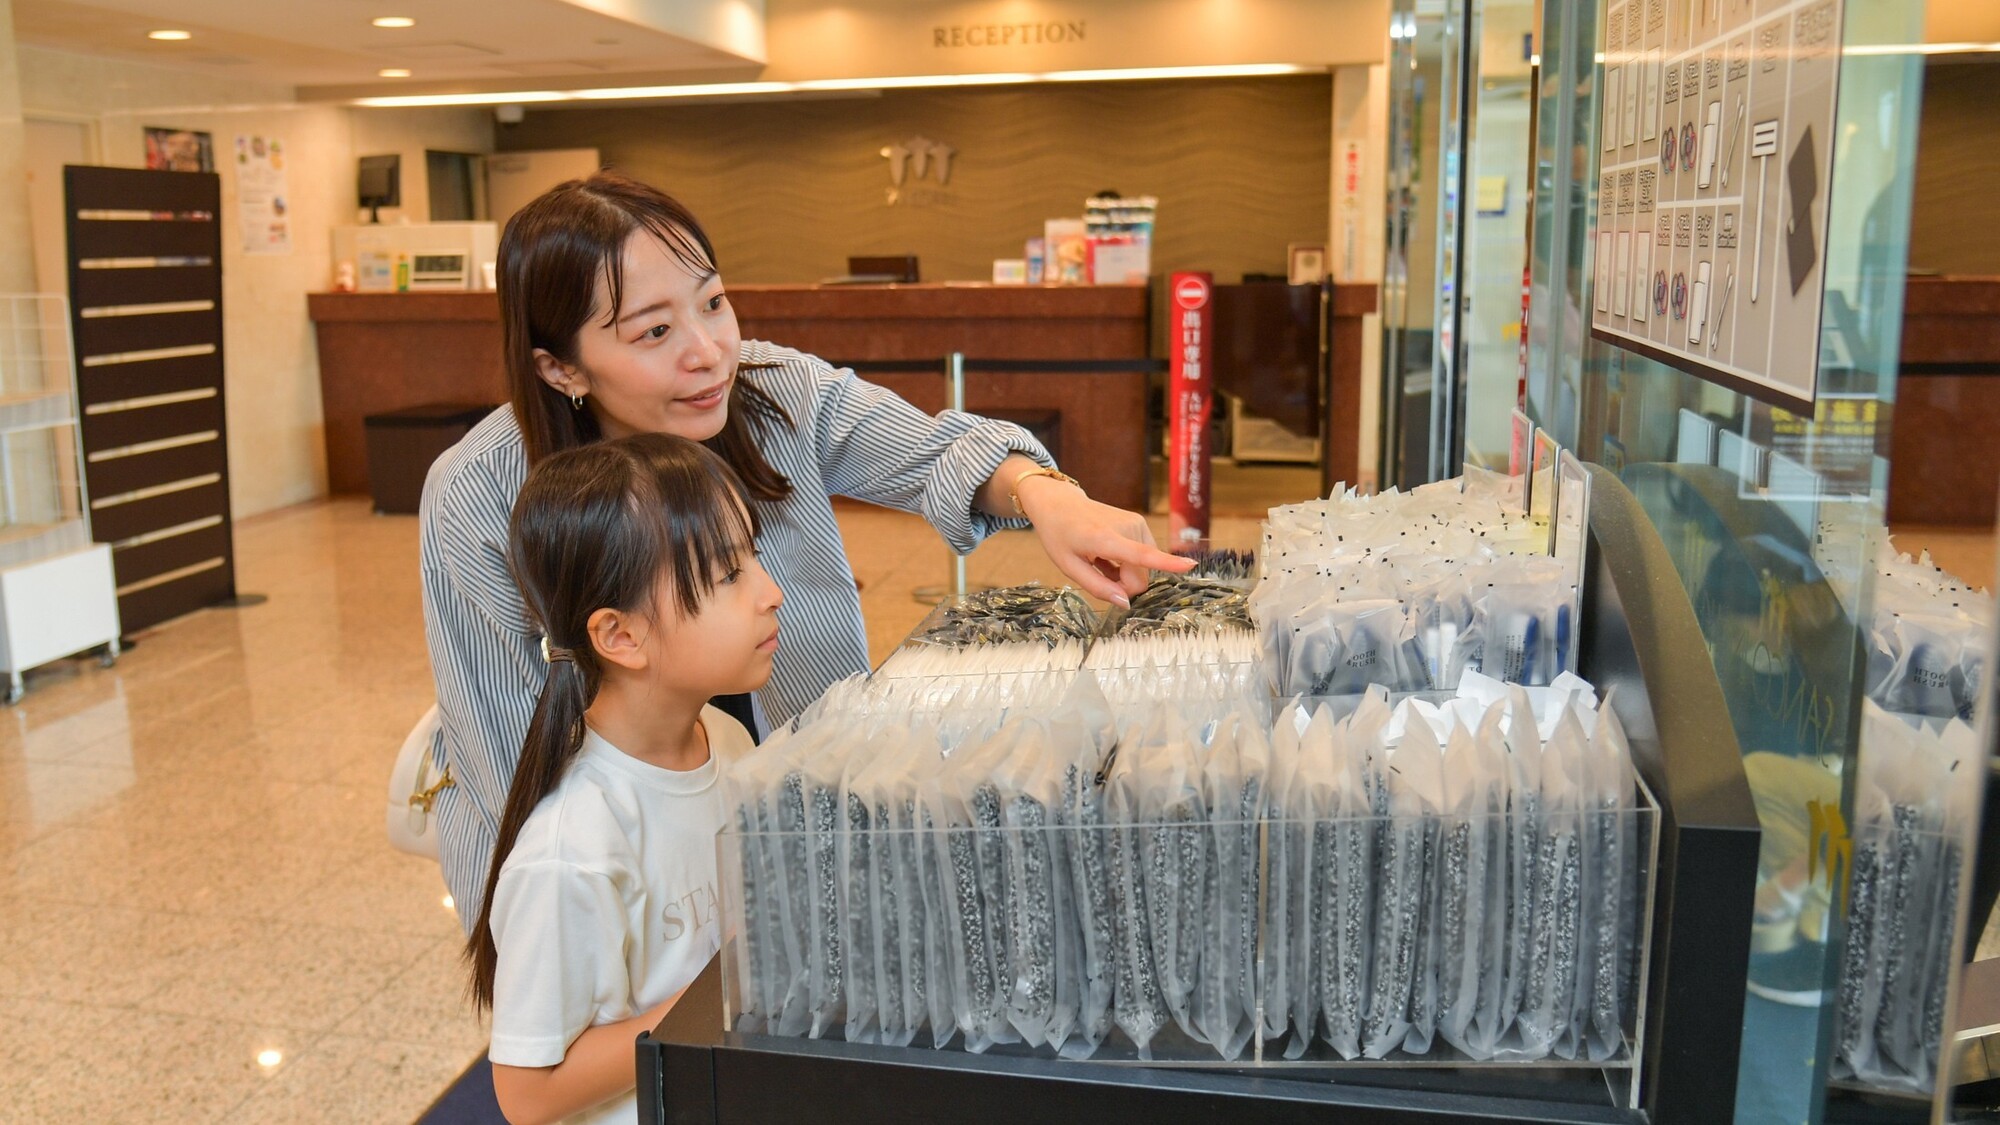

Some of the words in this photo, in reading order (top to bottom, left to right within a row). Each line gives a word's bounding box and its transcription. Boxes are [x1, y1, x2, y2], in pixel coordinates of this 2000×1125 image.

[933, 20, 1087, 48] RECEPTION
[1182, 310, 1201, 380] 出口専用
[1352, 648, 1377, 661] OOTH
